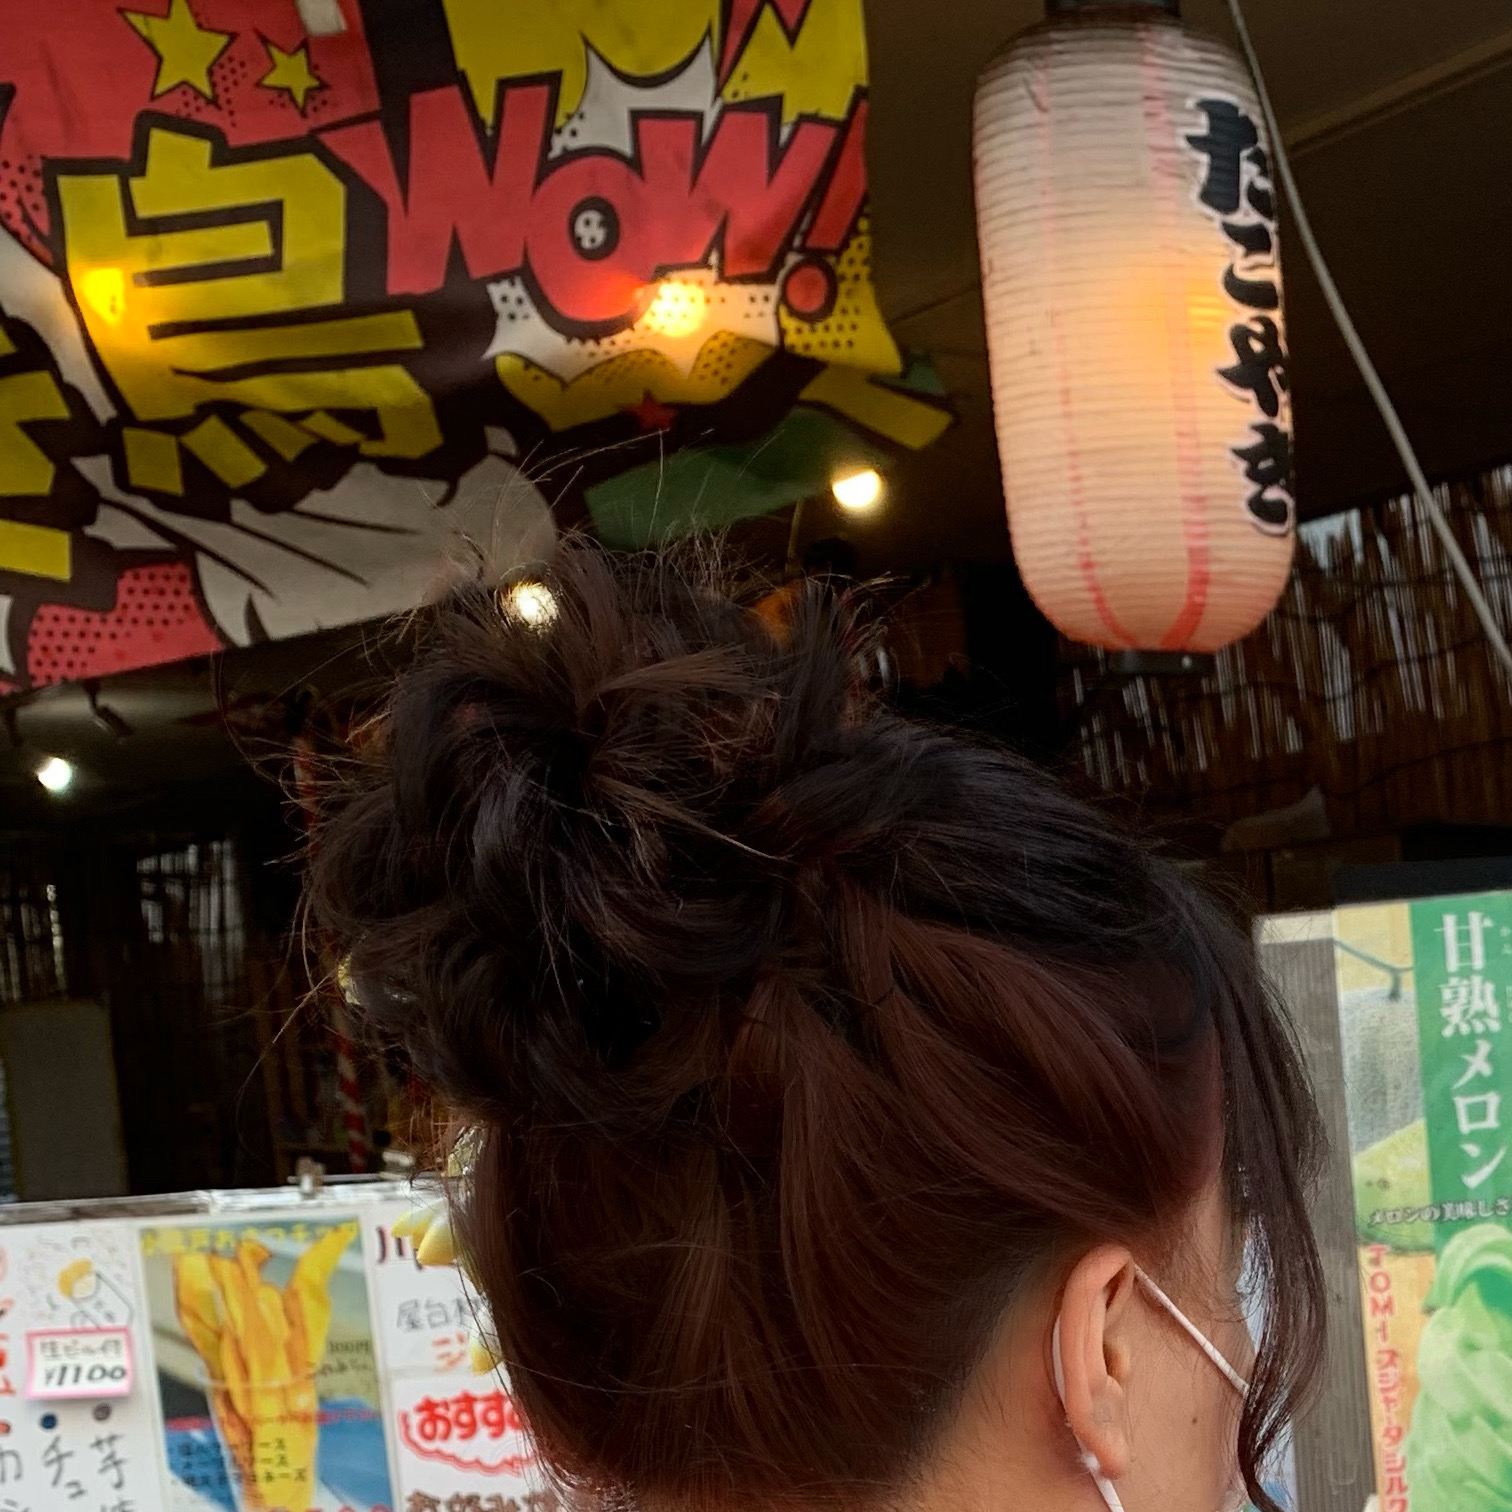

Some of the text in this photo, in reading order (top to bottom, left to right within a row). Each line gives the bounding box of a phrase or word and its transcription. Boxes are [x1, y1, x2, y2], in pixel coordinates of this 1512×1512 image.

[325, 80, 868, 326] WOW!
[1434, 911, 1507, 1189] 甘熟メロン
[43, 1362, 127, 1387] ¥1100
